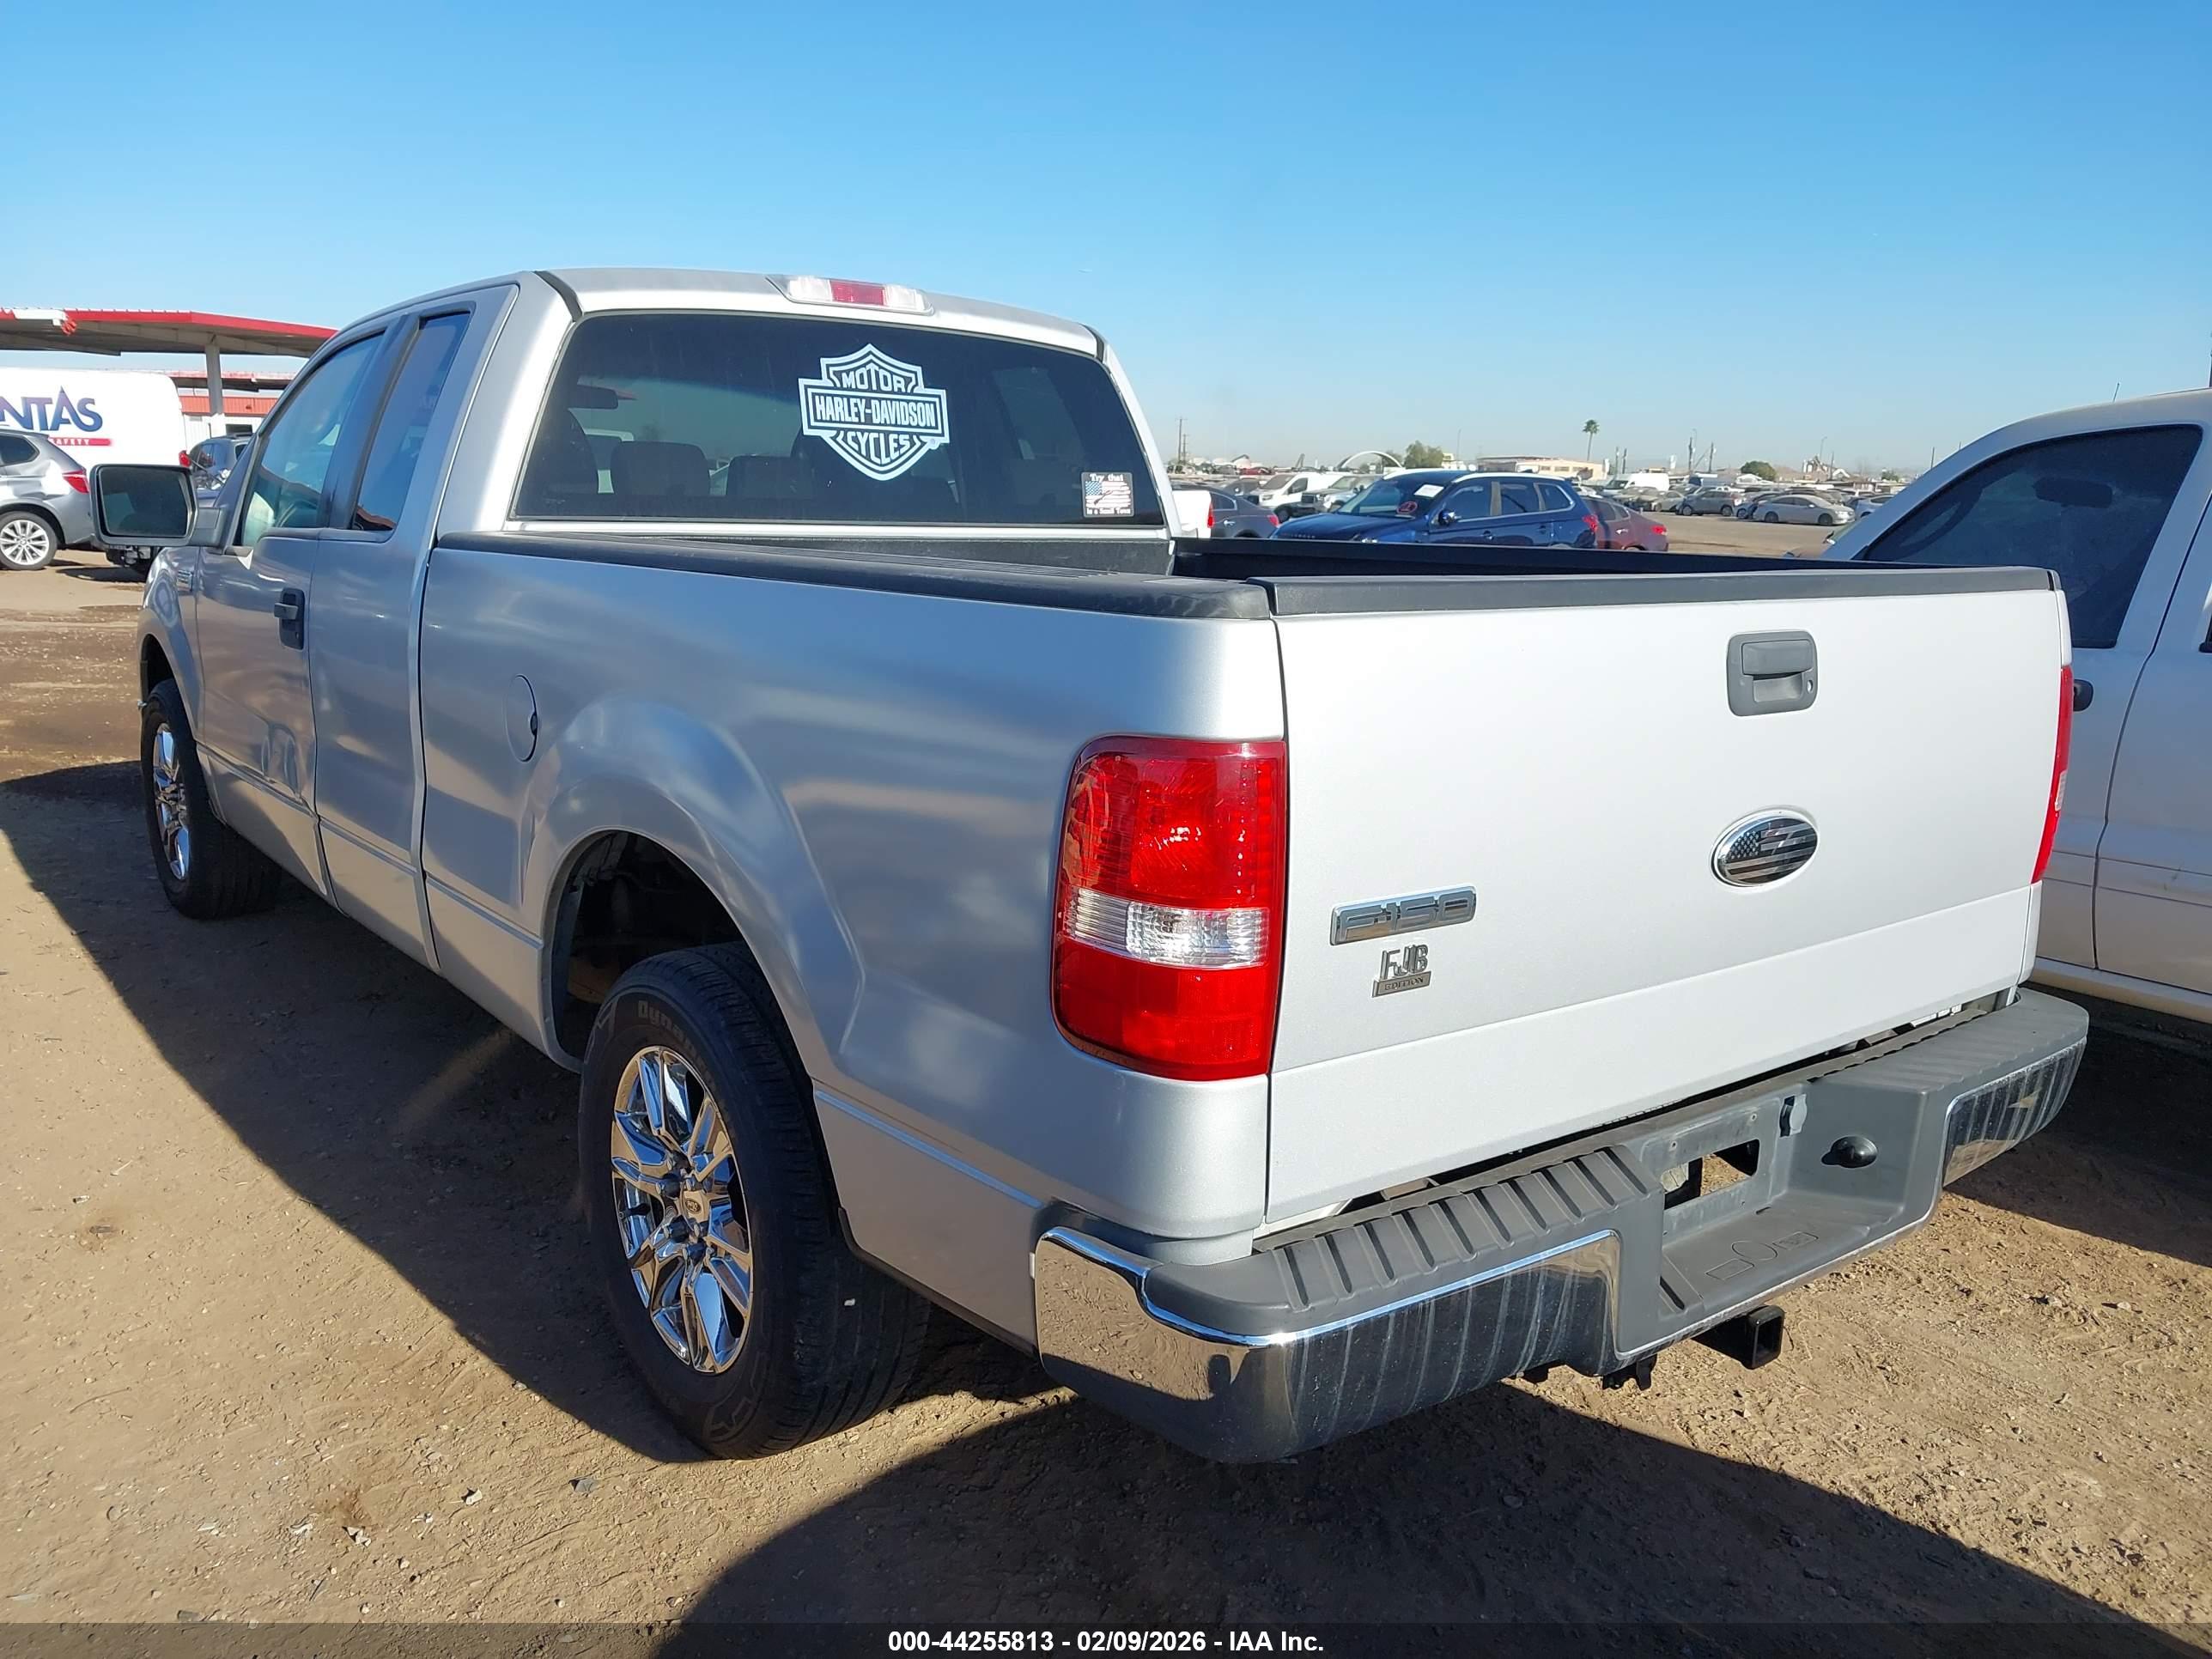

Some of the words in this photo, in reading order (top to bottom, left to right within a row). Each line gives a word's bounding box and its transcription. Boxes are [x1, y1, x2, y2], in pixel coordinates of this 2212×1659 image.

[842, 362, 906, 392] MOTOR
[815, 395, 936, 428] HARLEY-DAVIDSON
[847, 431, 911, 465] CYCLES
[1089, 473, 1105, 483] Try
[1108, 473, 1124, 482] that
[1379, 944, 1428, 981] FJB
[1384, 977, 1424, 990] EDITION
